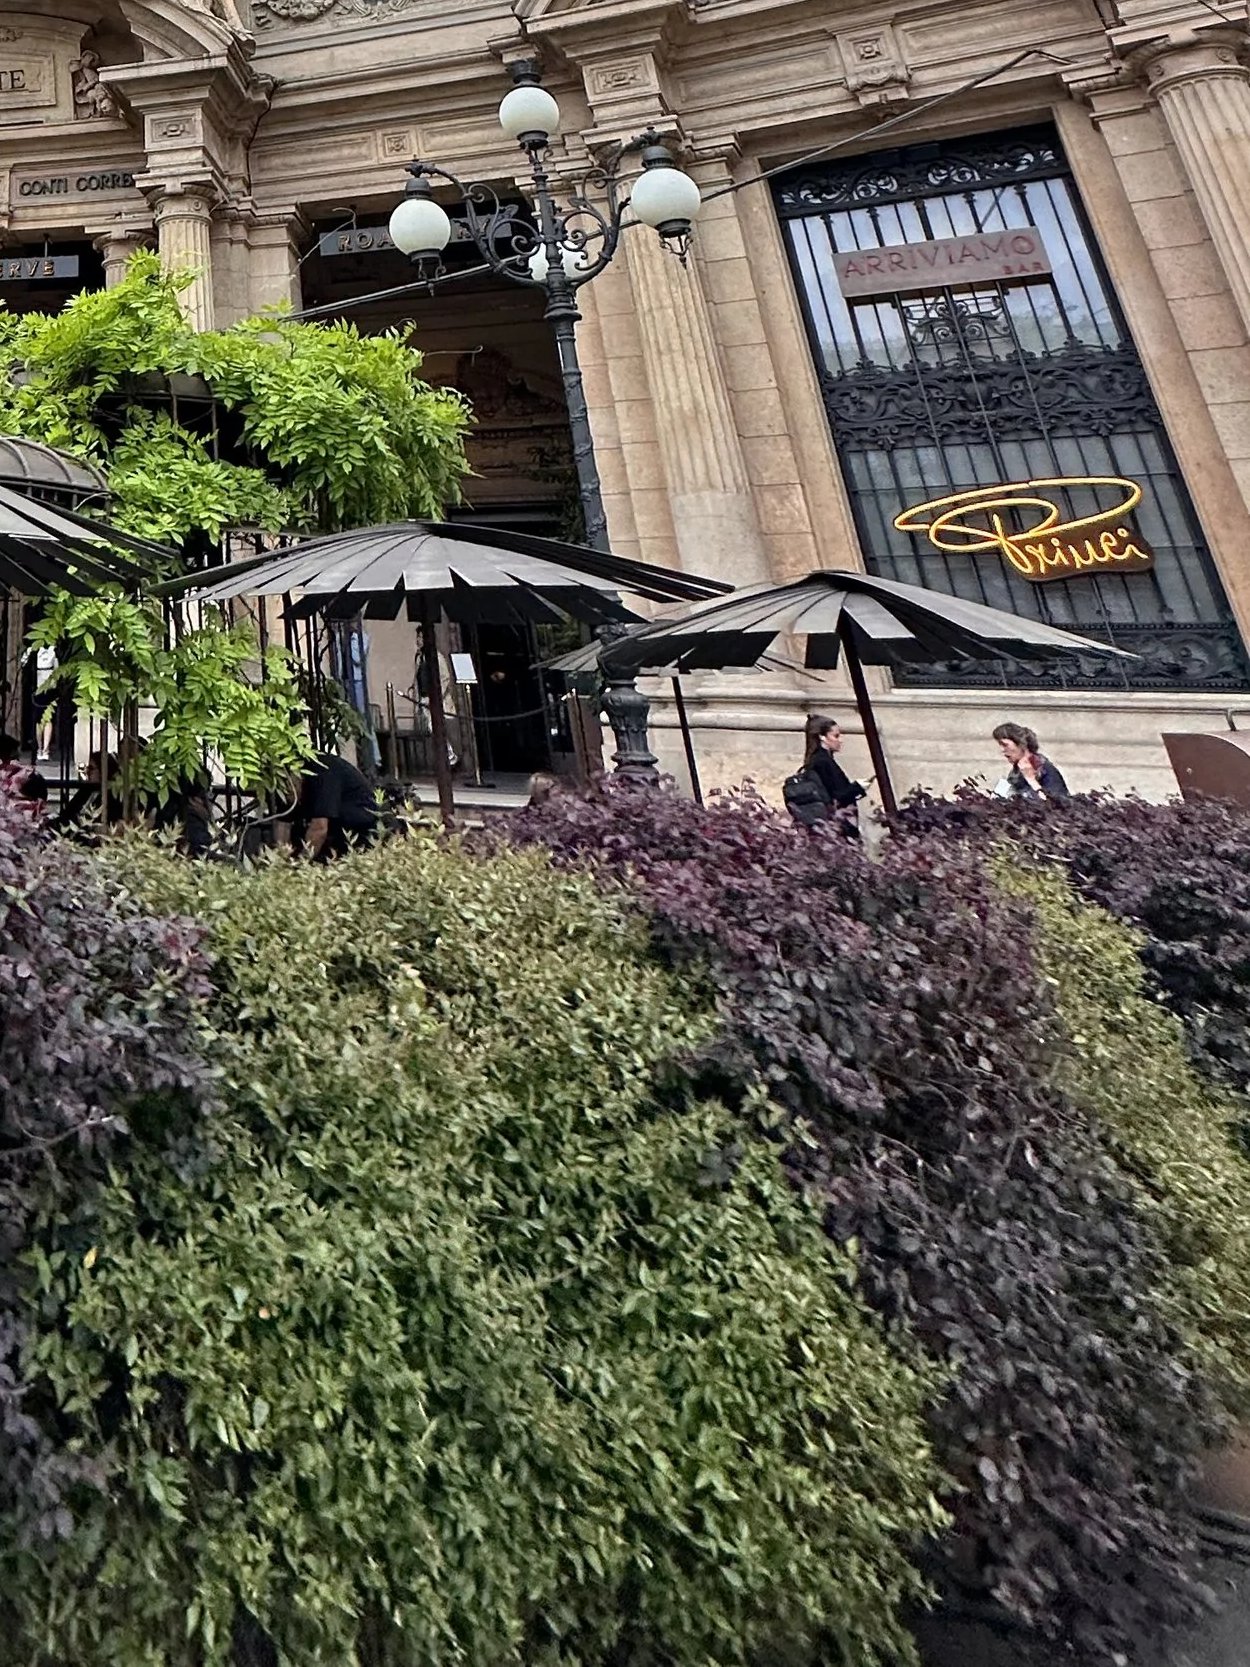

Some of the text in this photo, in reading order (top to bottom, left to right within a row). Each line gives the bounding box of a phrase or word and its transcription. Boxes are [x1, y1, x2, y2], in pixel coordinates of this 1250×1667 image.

[19, 177, 69, 196] CONTI
[844, 234, 1036, 279] ARRIVIAMO
[1001, 261, 1044, 275] BAR
[893, 476, 1149, 575] Princi
